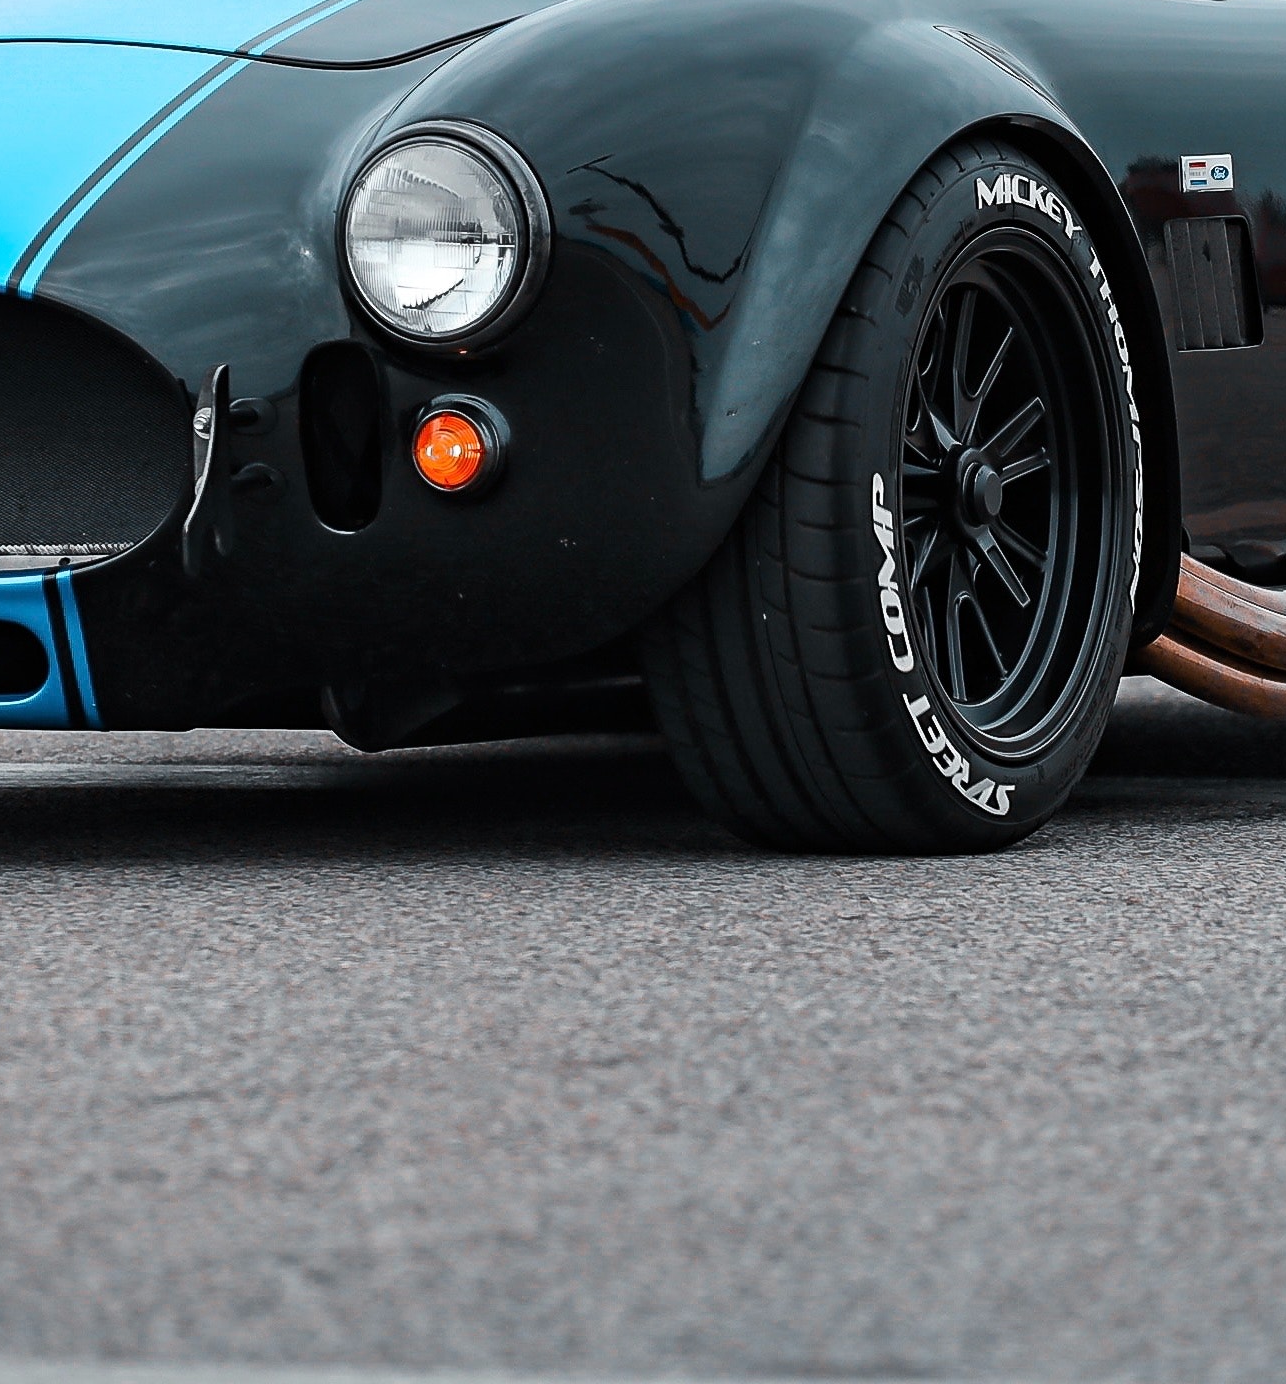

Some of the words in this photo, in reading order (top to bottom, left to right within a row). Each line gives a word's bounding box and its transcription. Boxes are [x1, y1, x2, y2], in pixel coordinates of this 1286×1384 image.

[976, 173, 1083, 240] MICKEY
[871, 472, 915, 673] COMP
[902, 693, 1016, 816] STREET
